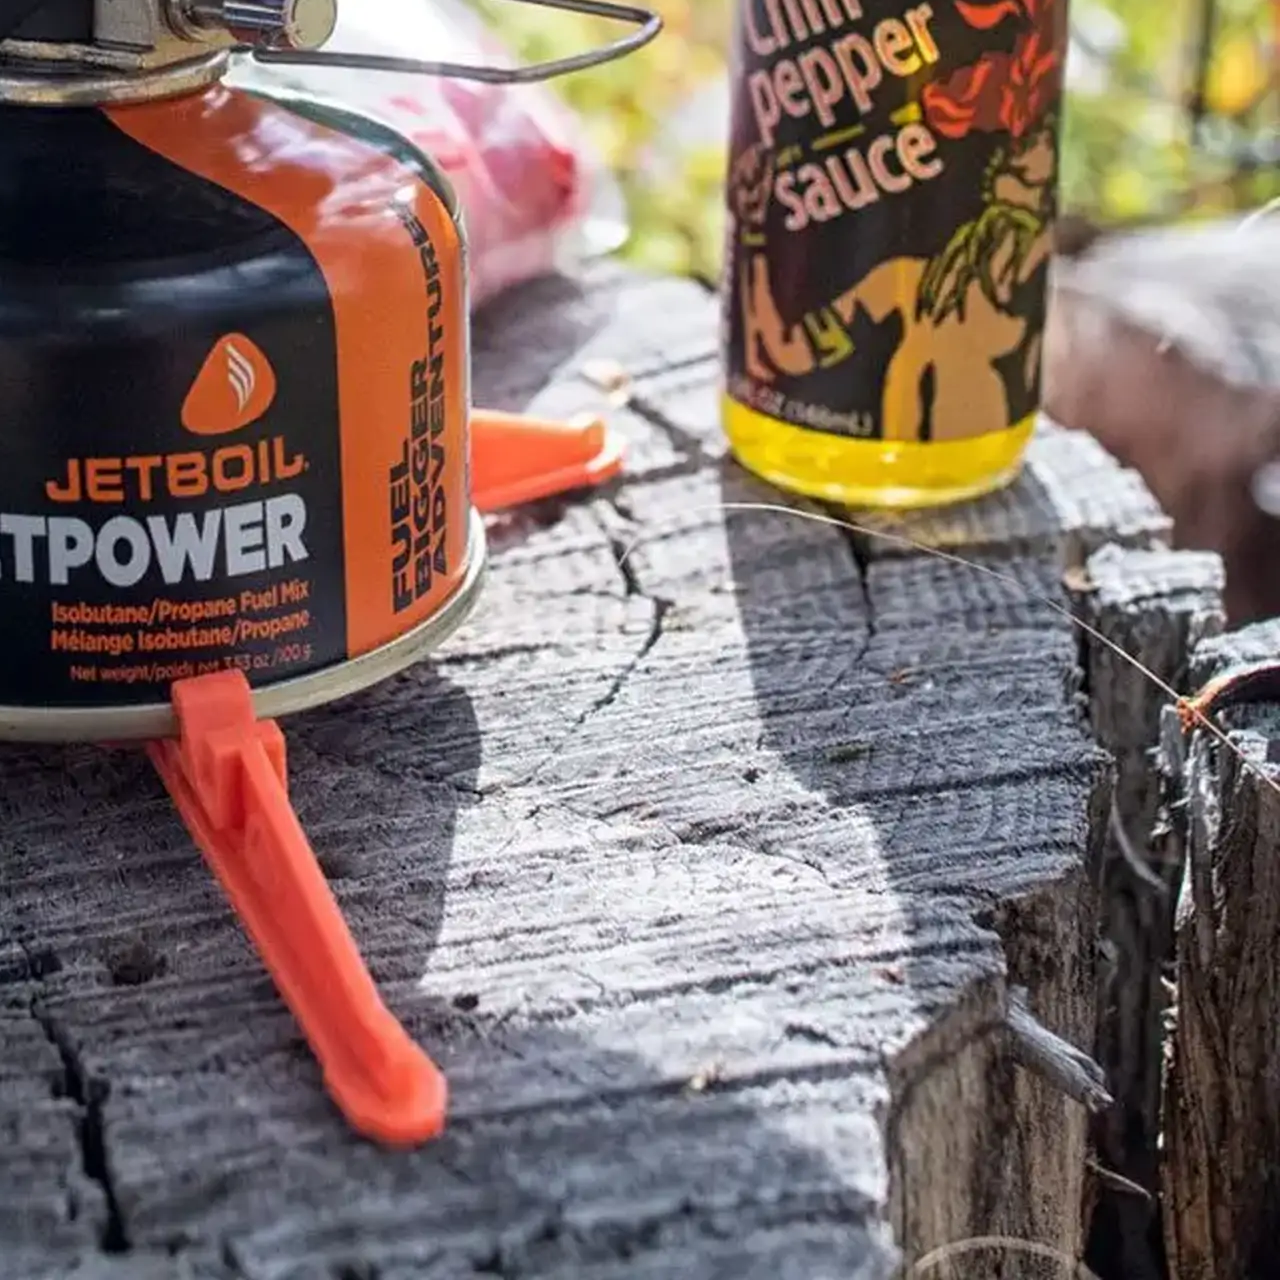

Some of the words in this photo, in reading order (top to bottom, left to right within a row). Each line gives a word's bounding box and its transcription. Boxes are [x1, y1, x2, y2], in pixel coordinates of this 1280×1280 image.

[748, 1, 939, 148] pepper
[775, 123, 943, 231] sauce
[45, 436, 306, 503] JETBOIL
[410, 355, 433, 601] BIGGER
[389, 437, 413, 615] FUEL
[51, 594, 238, 625] Isobutane/Propane
[240, 584, 278, 612] Fuel
[281, 578, 310, 604] Mix
[51, 629, 134, 655] Mélange
[138, 608, 311, 651] Isobutane/Propane
